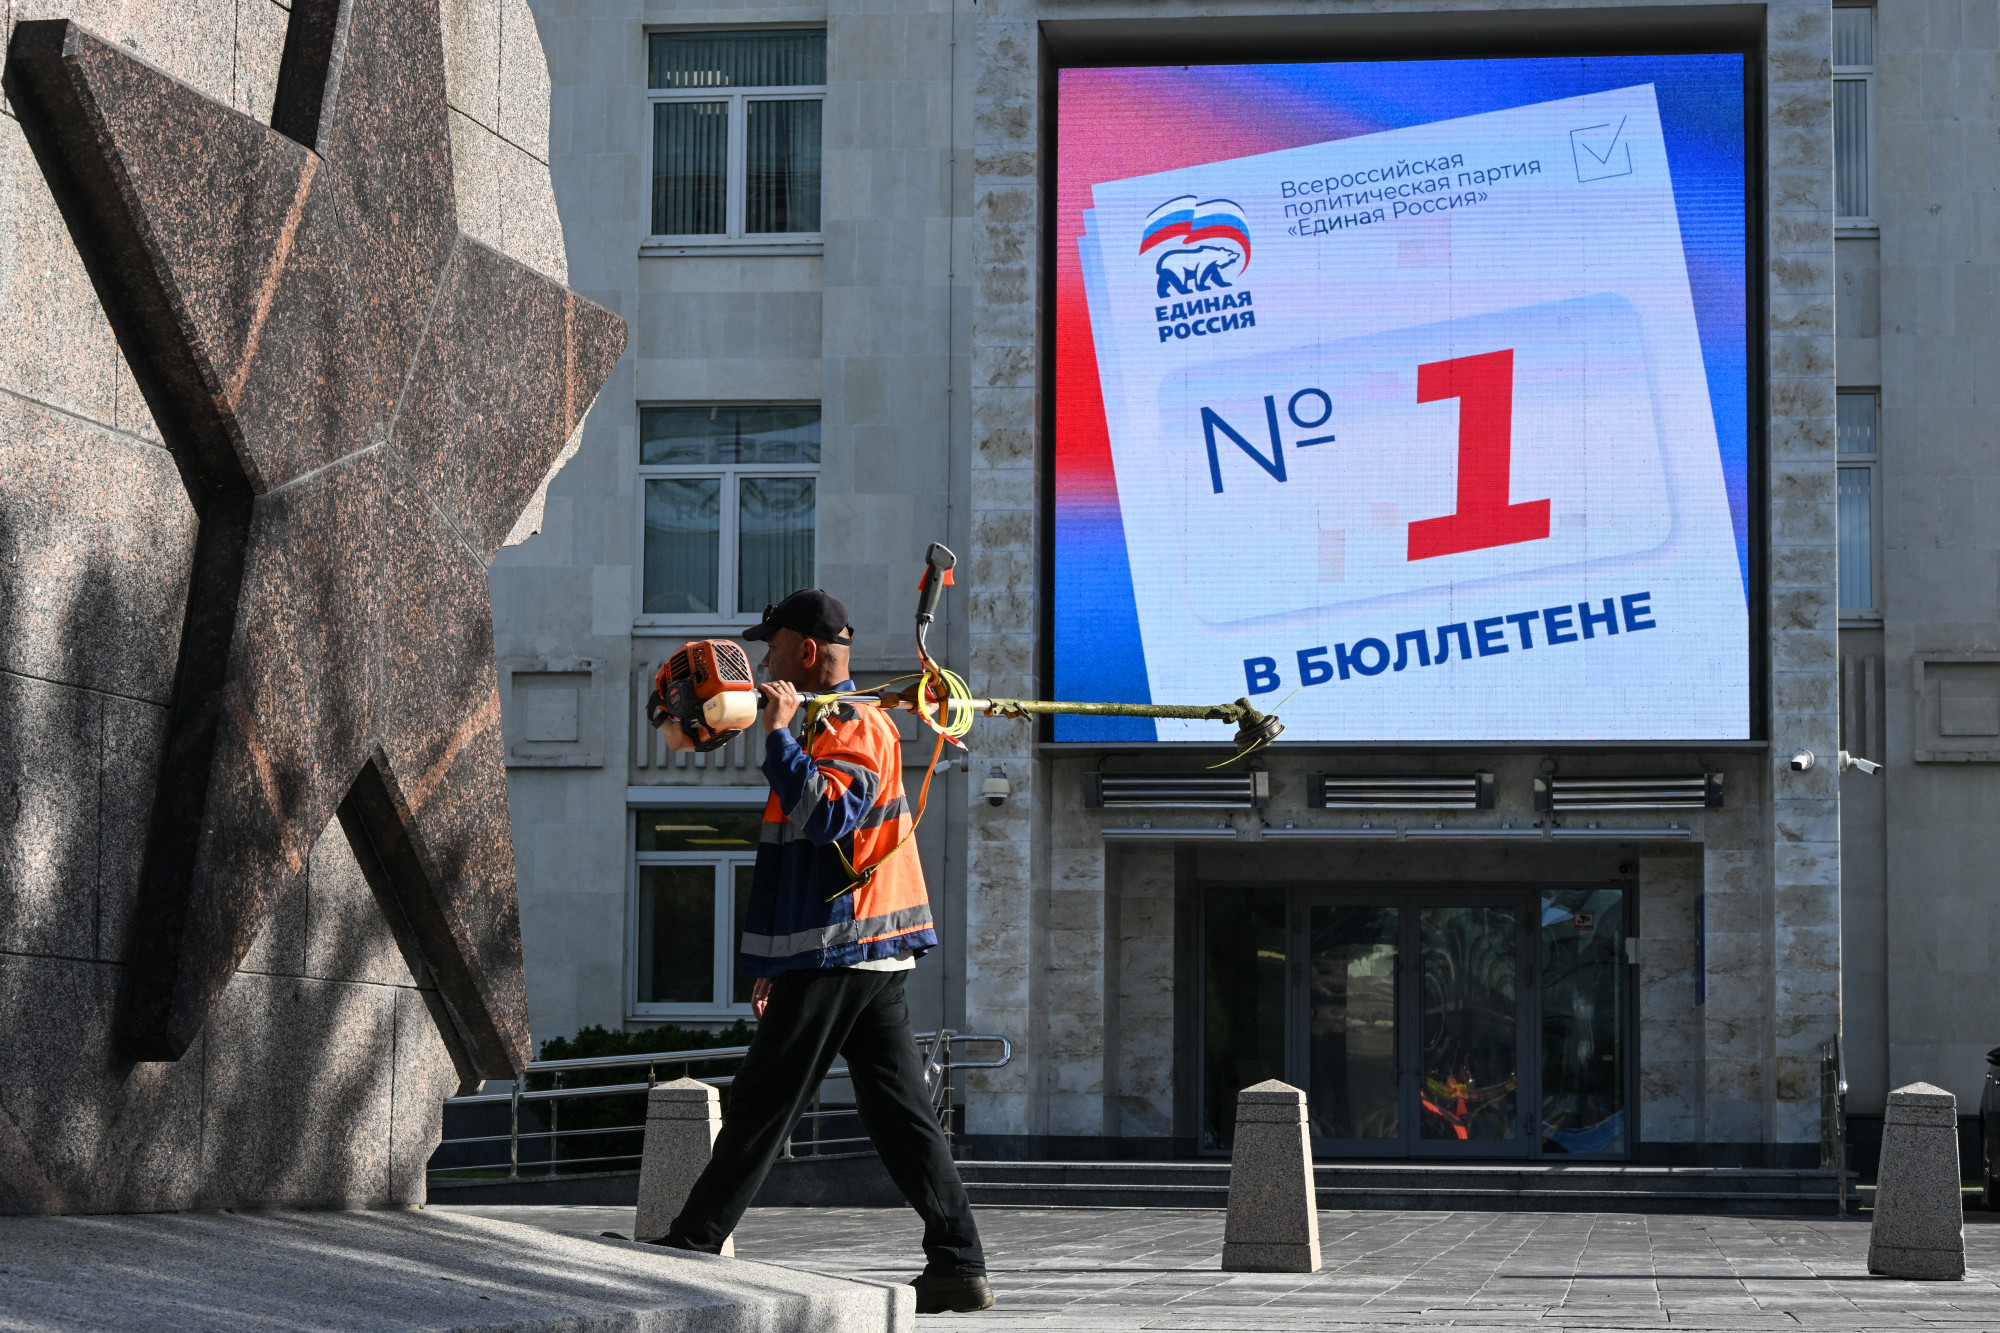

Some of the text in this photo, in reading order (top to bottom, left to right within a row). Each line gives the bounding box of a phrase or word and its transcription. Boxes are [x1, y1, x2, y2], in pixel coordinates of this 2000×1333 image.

[1280, 153, 1464, 199] Всероссийская
[1284, 159, 1542, 219] политическая партия
[1287, 191, 1488, 237] «Единая Россия»
[1155, 291, 1253, 322] ЕДИНАЯ
[1158, 311, 1256, 343] РОССИЯ
[1406, 348, 1551, 562] 1
[1243, 591, 1657, 696] В БЮЛЛЕТЕНЕ
